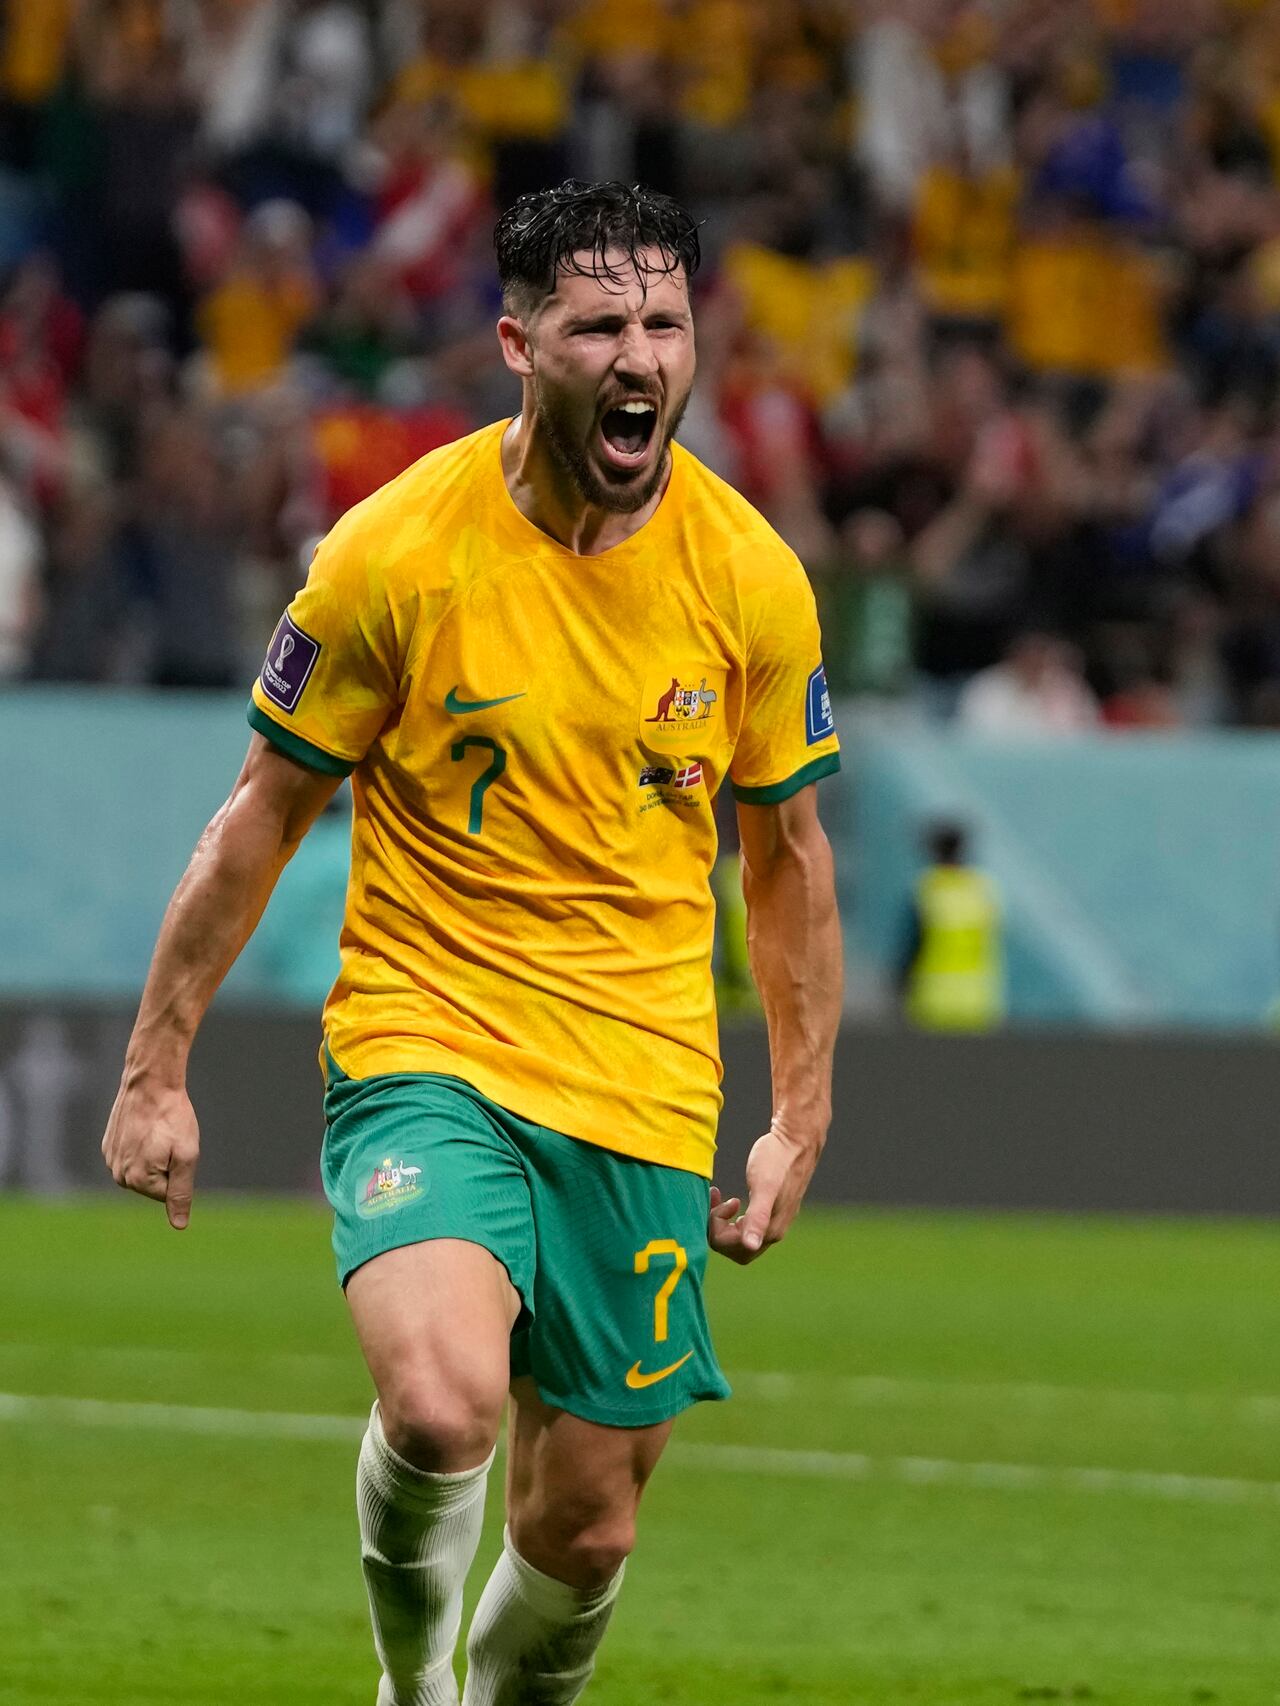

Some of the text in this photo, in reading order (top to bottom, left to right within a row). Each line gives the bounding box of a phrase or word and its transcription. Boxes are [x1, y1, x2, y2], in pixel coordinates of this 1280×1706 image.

[655, 720, 708, 733] AUSTRALIA
[451, 735, 507, 834] 7
[634, 1239, 688, 1342] 7
